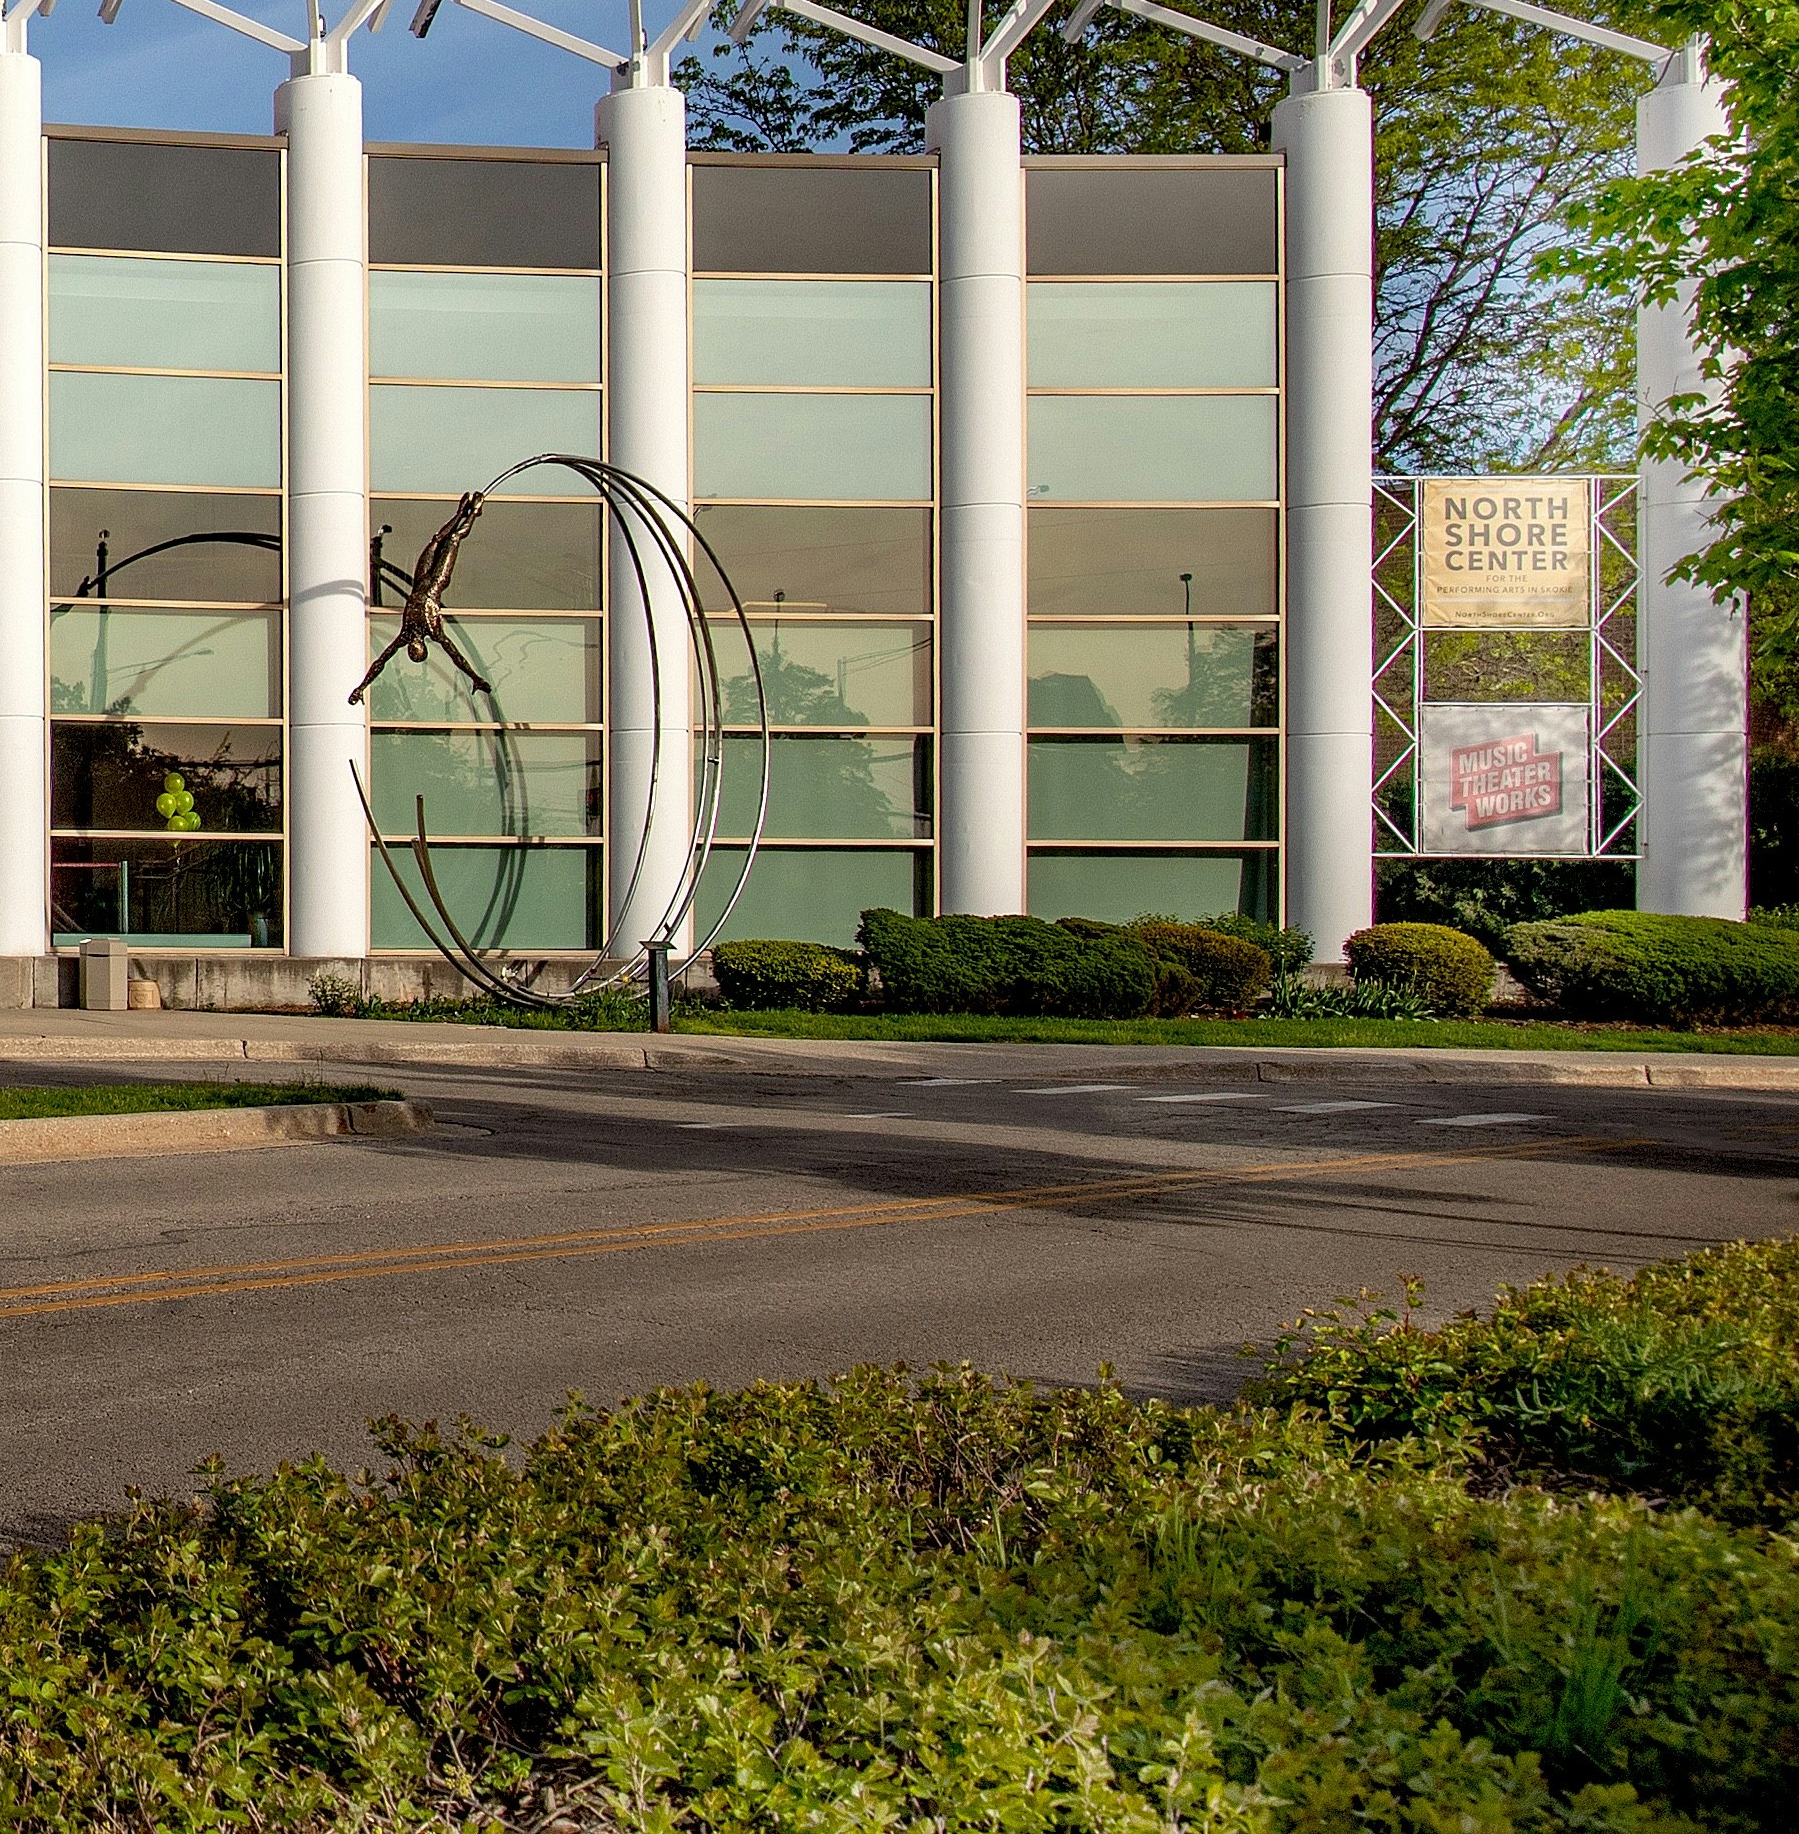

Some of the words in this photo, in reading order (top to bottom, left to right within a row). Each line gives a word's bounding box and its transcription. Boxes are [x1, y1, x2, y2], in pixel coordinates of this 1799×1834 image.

[1444, 497, 1568, 520] NORTH
[1444, 523, 1568, 547] SHORE
[1444, 550, 1568, 571] CENTER
[1436, 586, 1500, 594] PERFORMING
[1502, 586, 1525, 594] ARTS
[1527, 586, 1538, 594] IN
[1540, 586, 1573, 594] SKOKIE
[1486, 574, 1506, 583] FOR
[1509, 574, 1528, 583] THE
[1459, 742, 1528, 775] MUSIC
[1459, 761, 1551, 798] THEATER
[1475, 785, 1551, 819] WORKS
